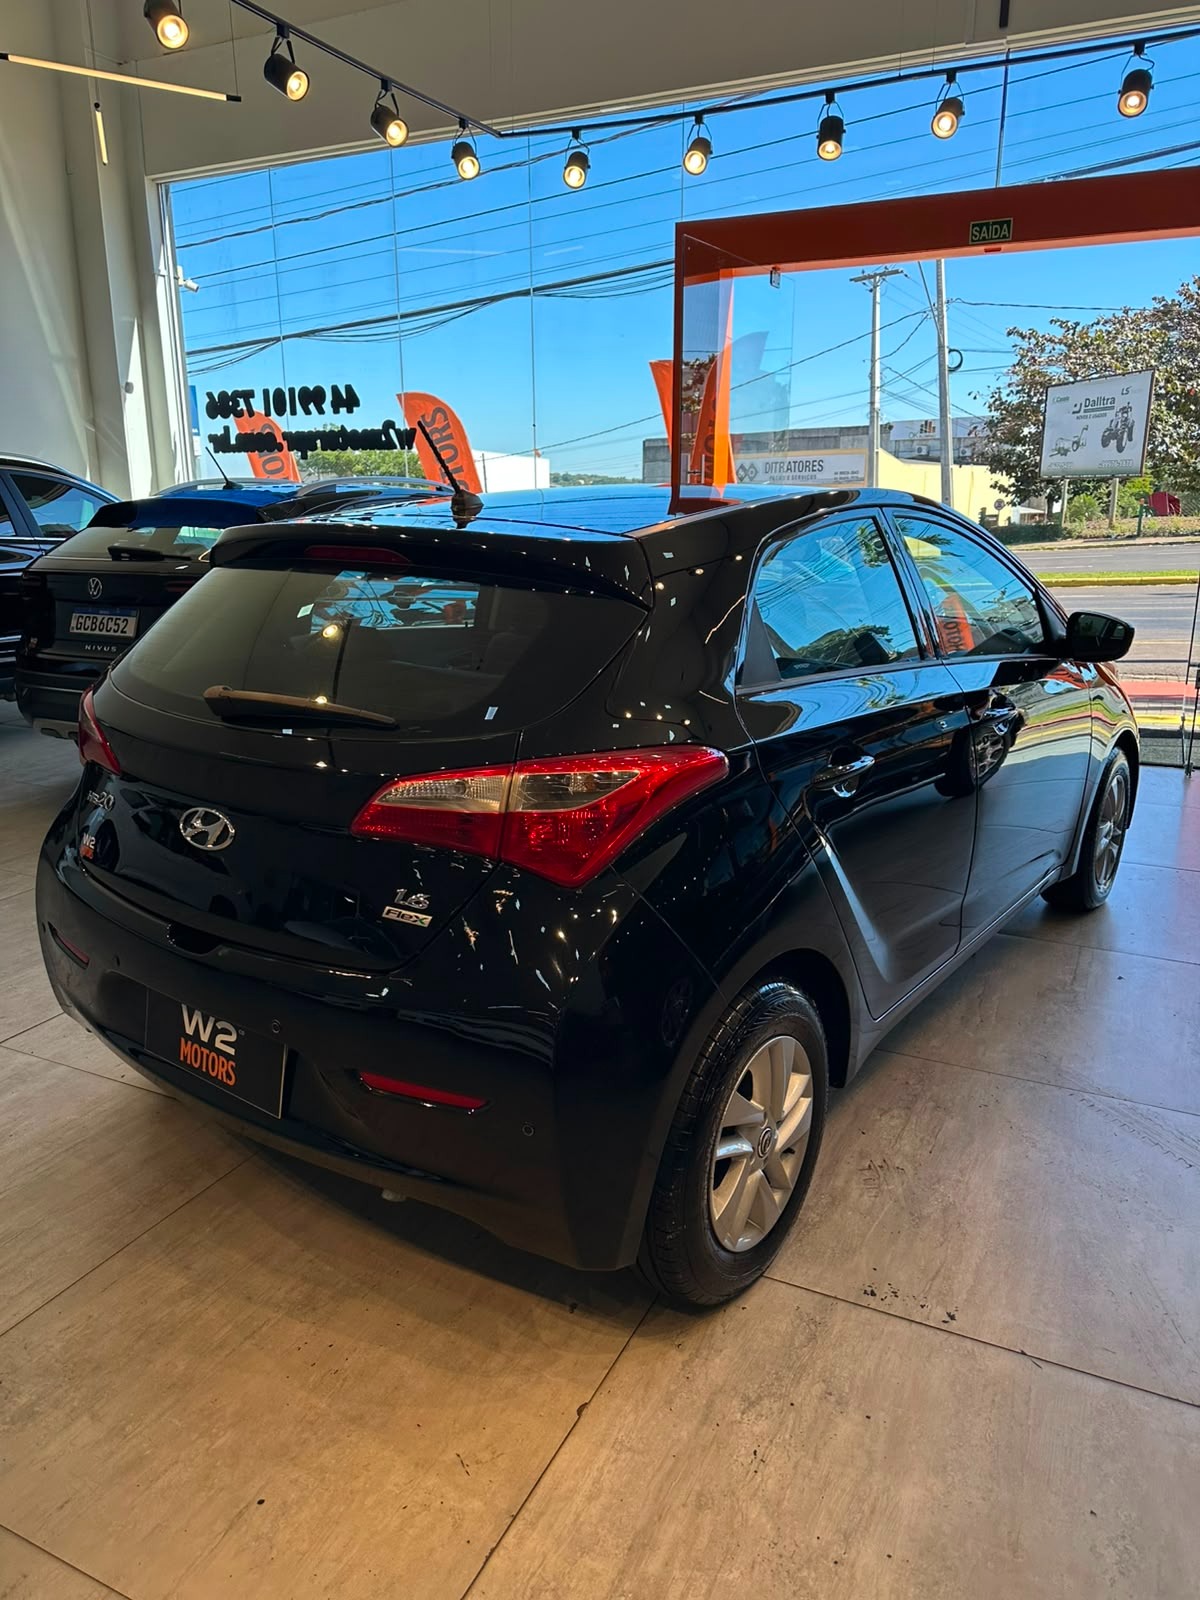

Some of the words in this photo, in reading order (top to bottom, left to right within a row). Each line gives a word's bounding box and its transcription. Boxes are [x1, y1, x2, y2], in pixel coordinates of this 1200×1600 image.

[972, 221, 1010, 241] SAÍDA
[1084, 396, 1116, 408] Dalltra
[764, 459, 825, 474] DITRATORES
[75, 615, 129, 634] GCB6C52
[84, 644, 117, 652] NIVUS
[385, 908, 430, 926] Flex
[181, 1003, 238, 1056] W2
[180, 1037, 237, 1087] MOTORS
